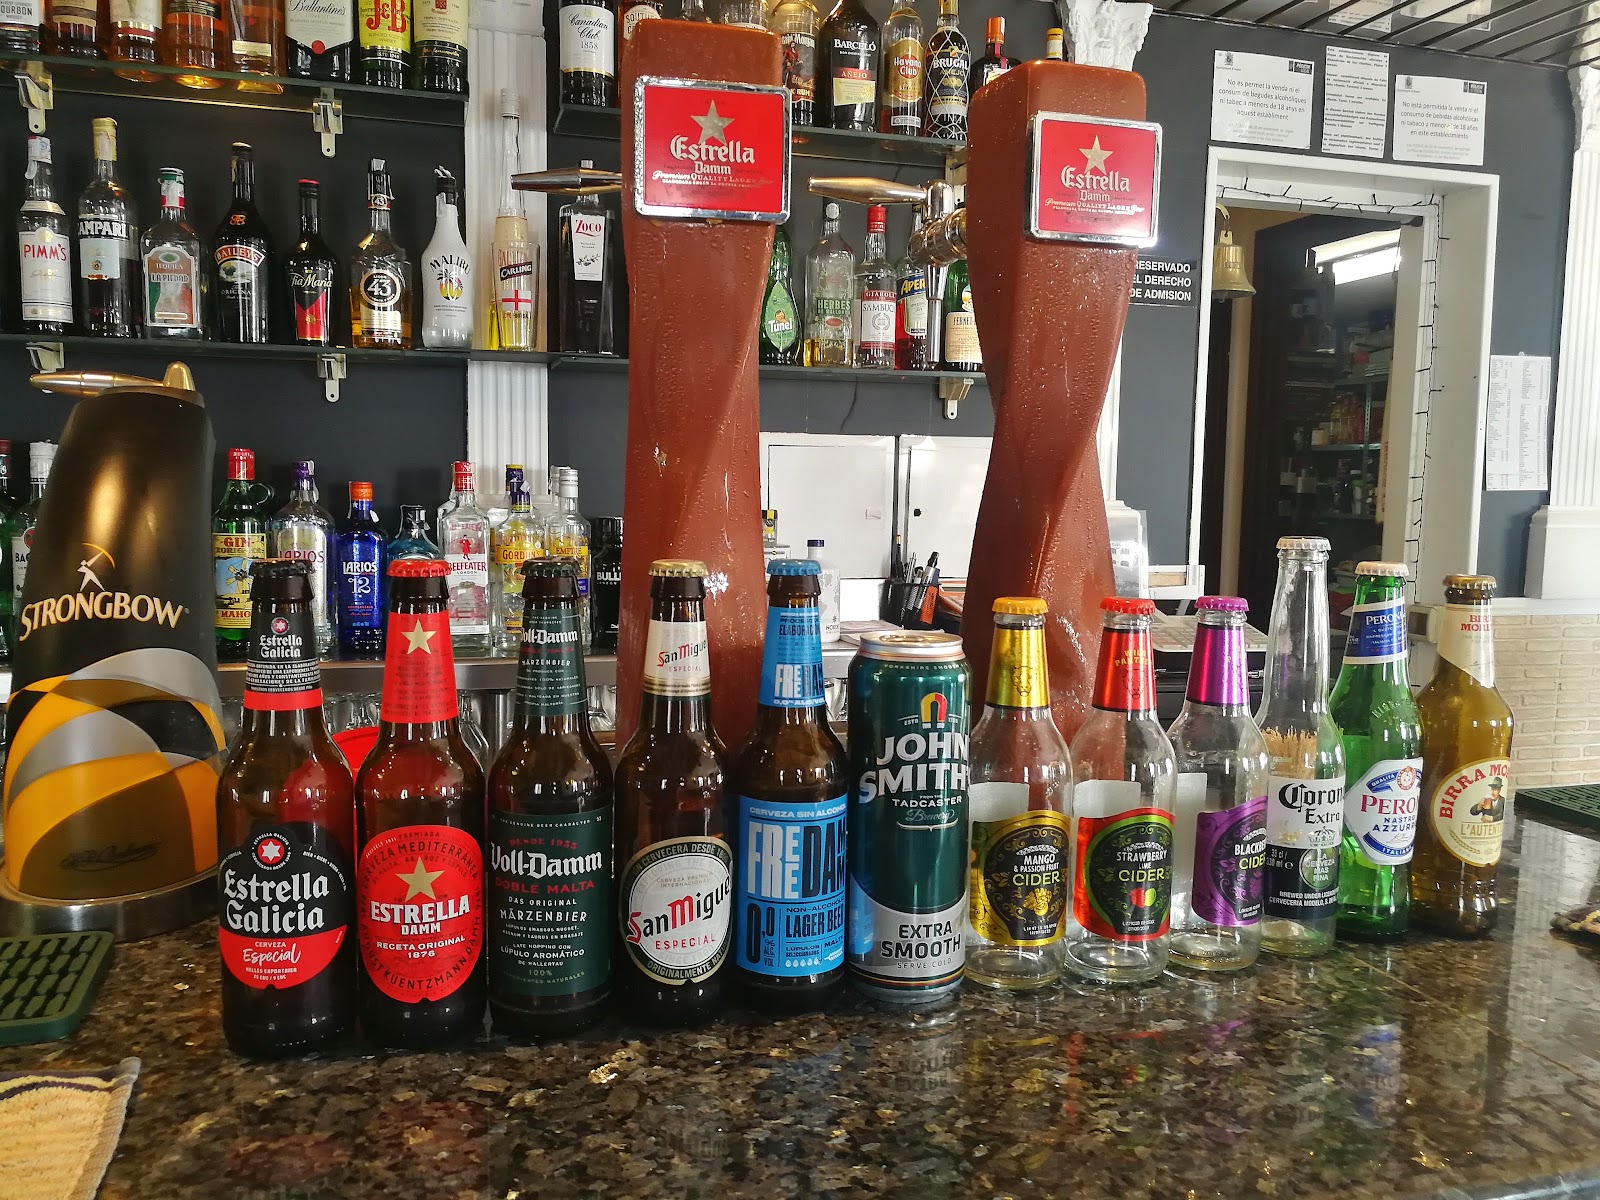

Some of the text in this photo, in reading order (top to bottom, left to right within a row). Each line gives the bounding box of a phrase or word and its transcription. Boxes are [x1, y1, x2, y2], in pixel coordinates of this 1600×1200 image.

[0, 6, 33, 16] OURBON
[288, 0, 347, 17] Ballantine's
[568, 13, 609, 31] Canadian
[577, 25, 600, 39] Club
[580, 41, 599, 49] 1858
[833, 38, 877, 52] BARCELÓ
[894, 57, 921, 68] Havana
[933, 57, 969, 70] BRUGAL
[841, 70, 868, 78] AÑEJO
[900, 66, 917, 76] Club
[1218, 88, 1241, 96] consum
[1241, 89, 1250, 97] de
[1250, 90, 1274, 100] begudes
[1271, 84, 1288, 92] venda
[1226, 98, 1242, 106] tabac
[1247, 101, 1269, 109] menors
[1269, 102, 1277, 110] de
[1278, 103, 1285, 111] 18
[1422, 103, 1448, 111] permitida
[1453, 105, 1468, 113] venta
[1236, 110, 1289, 120] aquest establiment
[1432, 112, 1453, 121] bebidas
[1466, 124, 1479, 132] años
[1429, 131, 1469, 140] establecimiento
[669, 134, 756, 165] Estrella
[693, 161, 732, 175] Damm
[651, 170, 692, 181] Premium
[690, 172, 729, 182] QUALITY
[1060, 165, 1131, 192] Estrella
[1079, 190, 1111, 202] Damm
[1076, 200, 1108, 210] QUALITY
[79, 220, 129, 238] AMPARI
[23, 243, 68, 262] PIMM'S
[216, 247, 262, 263] BAILEYS
[155, 262, 184, 271] TEQUILA
[429, 254, 471, 276] MALIBU
[500, 264, 532, 279] CARLING
[151, 273, 189, 283] LA PIEDAD
[302, 273, 333, 289] Maria
[1144, 274, 1192, 288] DERECHO
[367, 278, 392, 297] 43
[901, 279, 927, 296] APER
[1143, 288, 1193, 301] ADMISION
[817, 299, 851, 310] HERBES
[862, 303, 895, 313] SAMBUC
[555, 547, 582, 555] EMPIRE
[342, 561, 378, 576] LARIOS
[347, 576, 371, 594] 12
[19, 591, 185, 642] STRONGBOW
[259, 634, 303, 647] Estrella
[260, 646, 301, 659] Galicia
[884, 664, 930, 672] YORKSHIRE
[903, 719, 919, 727] ESTD
[876, 731, 970, 767] JOHN
[858, 762, 970, 804] SMITH'
[1278, 783, 1344, 812] Coron
[1439, 767, 1487, 819] BIRRA
[891, 795, 963, 808] TADCASTER
[1360, 794, 1419, 816] PERO
[749, 805, 796, 818] CERVEZA
[796, 807, 815, 818] SIN
[905, 808, 956, 823] Brewery
[1304, 808, 1340, 825] Extra
[1383, 815, 1416, 824] NASTRO
[1372, 823, 1416, 832] AZZURR
[641, 842, 716, 867] CERVECERA DESDE
[1234, 839, 1267, 856] BLACKBE
[1271, 848, 1278, 857] 33
[490, 841, 603, 880] Voll-Damm
[747, 820, 801, 900] FREE
[1023, 853, 1056, 866] MANGO
[1116, 850, 1168, 862] STRAWBERRY
[1238, 852, 1267, 870] CIDE
[1013, 862, 1060, 873] & PASSION FRUIT
[656, 876, 686, 884] CERVEZA
[1012, 870, 1061, 887] CIDER
[1118, 868, 1166, 883] CIDER
[223, 868, 330, 904] Estrella
[495, 877, 596, 895] DOBLE MALTA
[508, 895, 578, 906] DAS ORIGINAL
[1279, 890, 1303, 899] BREWED
[370, 894, 471, 925] ESTRELLA
[500, 907, 588, 922] MÄRZENBIER
[626, 876, 731, 945] San Migue
[226, 900, 326, 934] Galicia
[785, 909, 826, 938] LAGER
[400, 922, 442, 936] DAMM
[898, 920, 953, 940] EXTRA
[376, 934, 467, 951] RECETA ORIGINAL
[655, 933, 716, 950] ESPECIAL
[880, 933, 962, 960] SMOOTH
[242, 943, 302, 967] Especial
[406, 949, 437, 960] 1876
[500, 944, 586, 959] LÚPULO AROMÁTICO
[646, 960, 712, 979] ORIGINALMENTE
[896, 958, 953, 970] SERVE COLD
